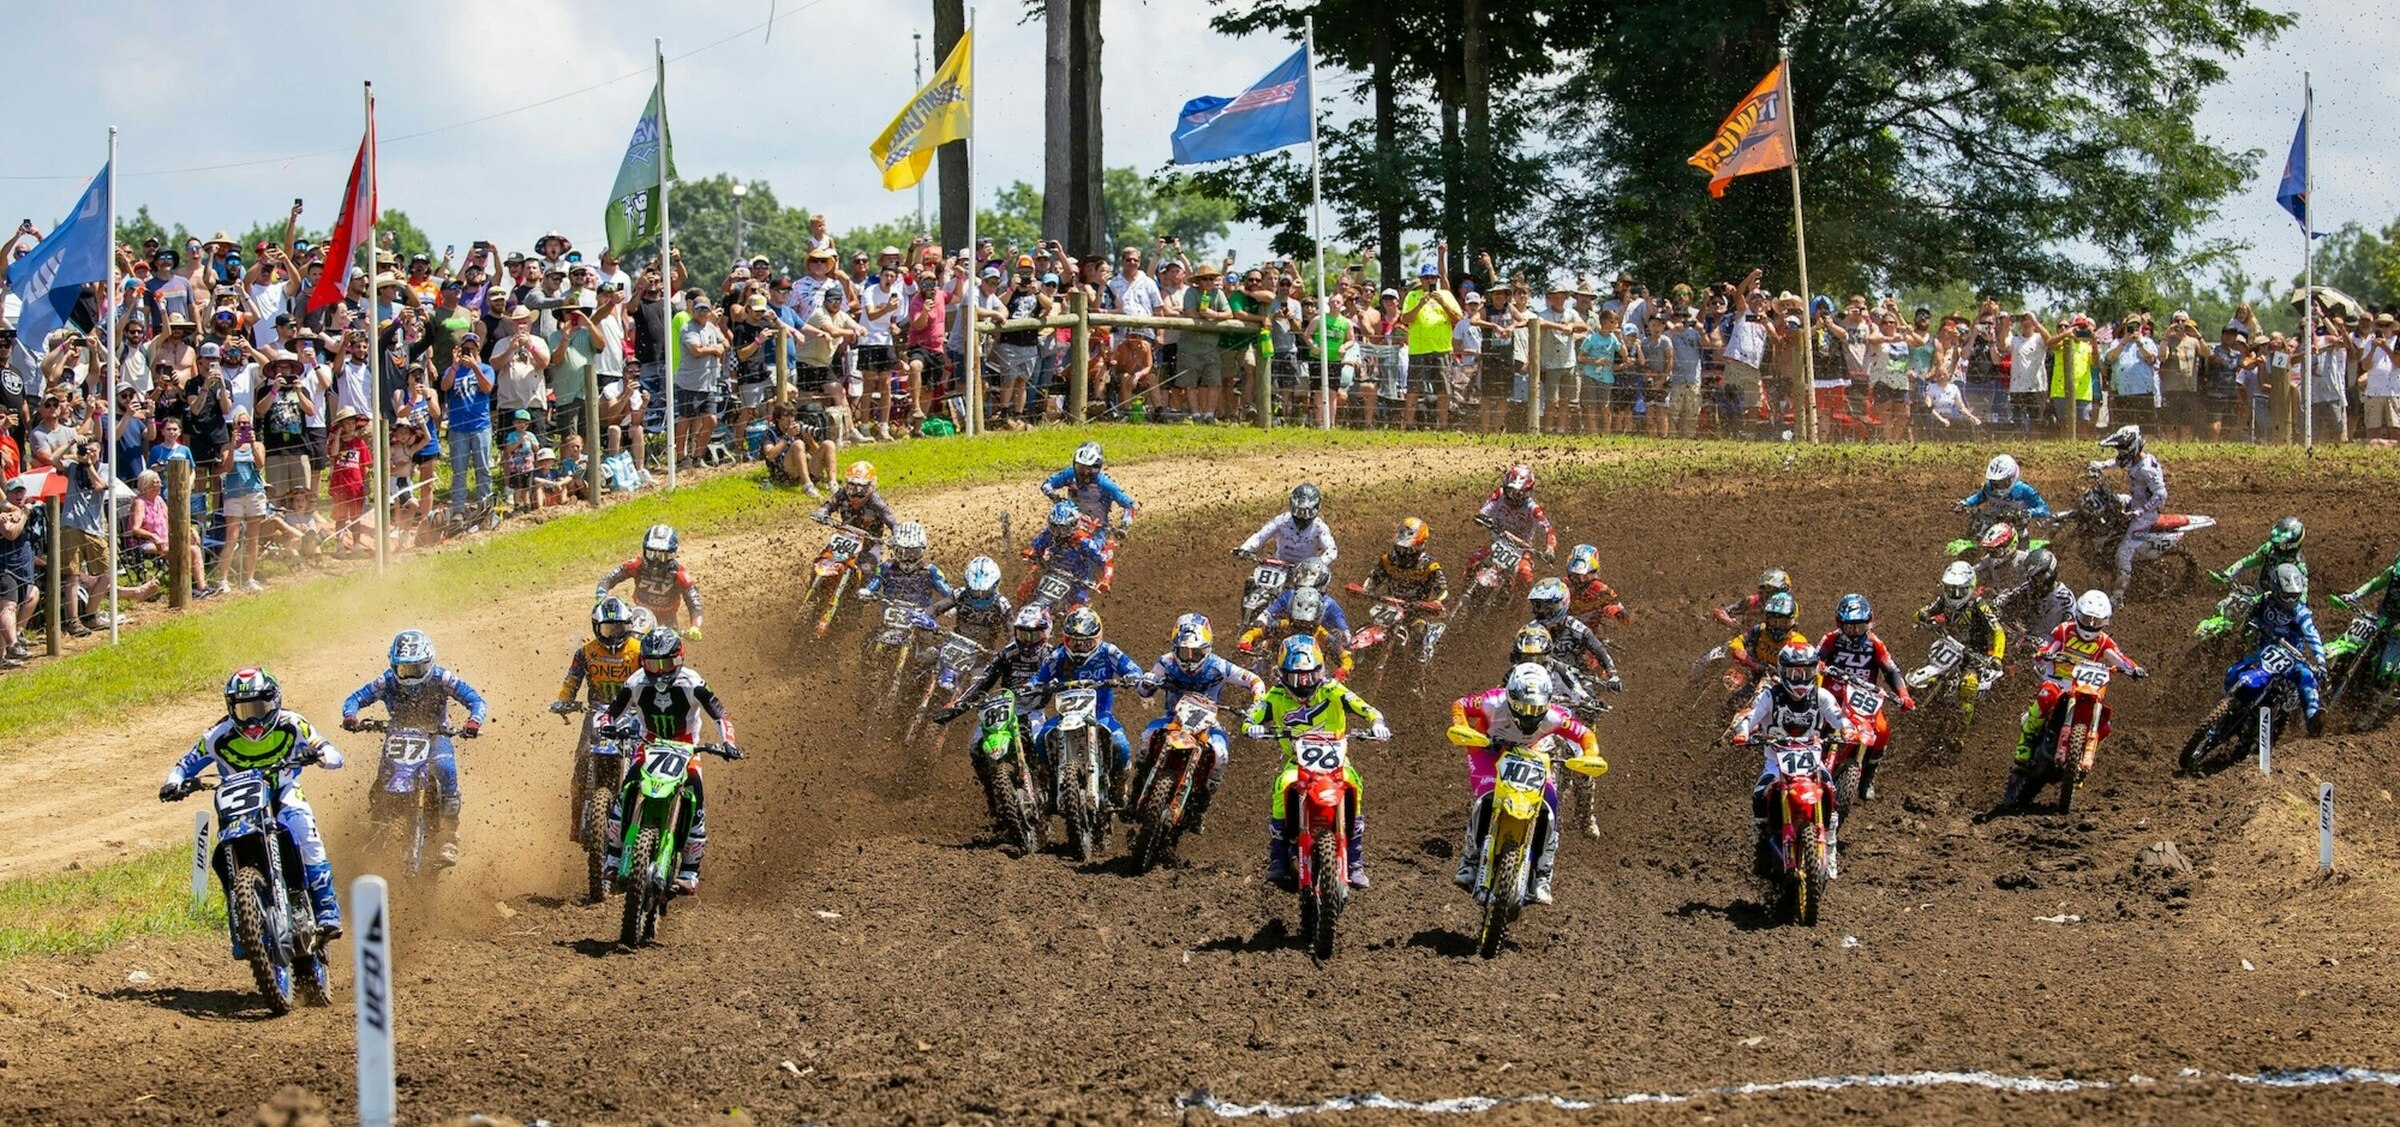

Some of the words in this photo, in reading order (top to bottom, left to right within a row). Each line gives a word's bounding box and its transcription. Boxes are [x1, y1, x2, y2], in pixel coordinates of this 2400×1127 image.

[639, 580, 674, 595] FLY
[1259, 570, 1280, 586] 81
[1834, 651, 1873, 668] FLY
[2261, 651, 2294, 673] 573
[1079, 667, 1106, 680] FXR
[1060, 695, 1095, 713] 27
[1850, 690, 1879, 714] 69
[984, 705, 1010, 728] 86
[1184, 709, 1208, 728] 1
[389, 738, 427, 761] 37
[1302, 747, 1340, 769] 96
[647, 751, 688, 777] 70
[1782, 752, 1818, 774] 14
[1501, 761, 1546, 789] 102
[218, 781, 262, 817] 3
[2322, 802, 2331, 832] UFO
[196, 836, 208, 870] UFO
[363, 947, 387, 1034] UFO
